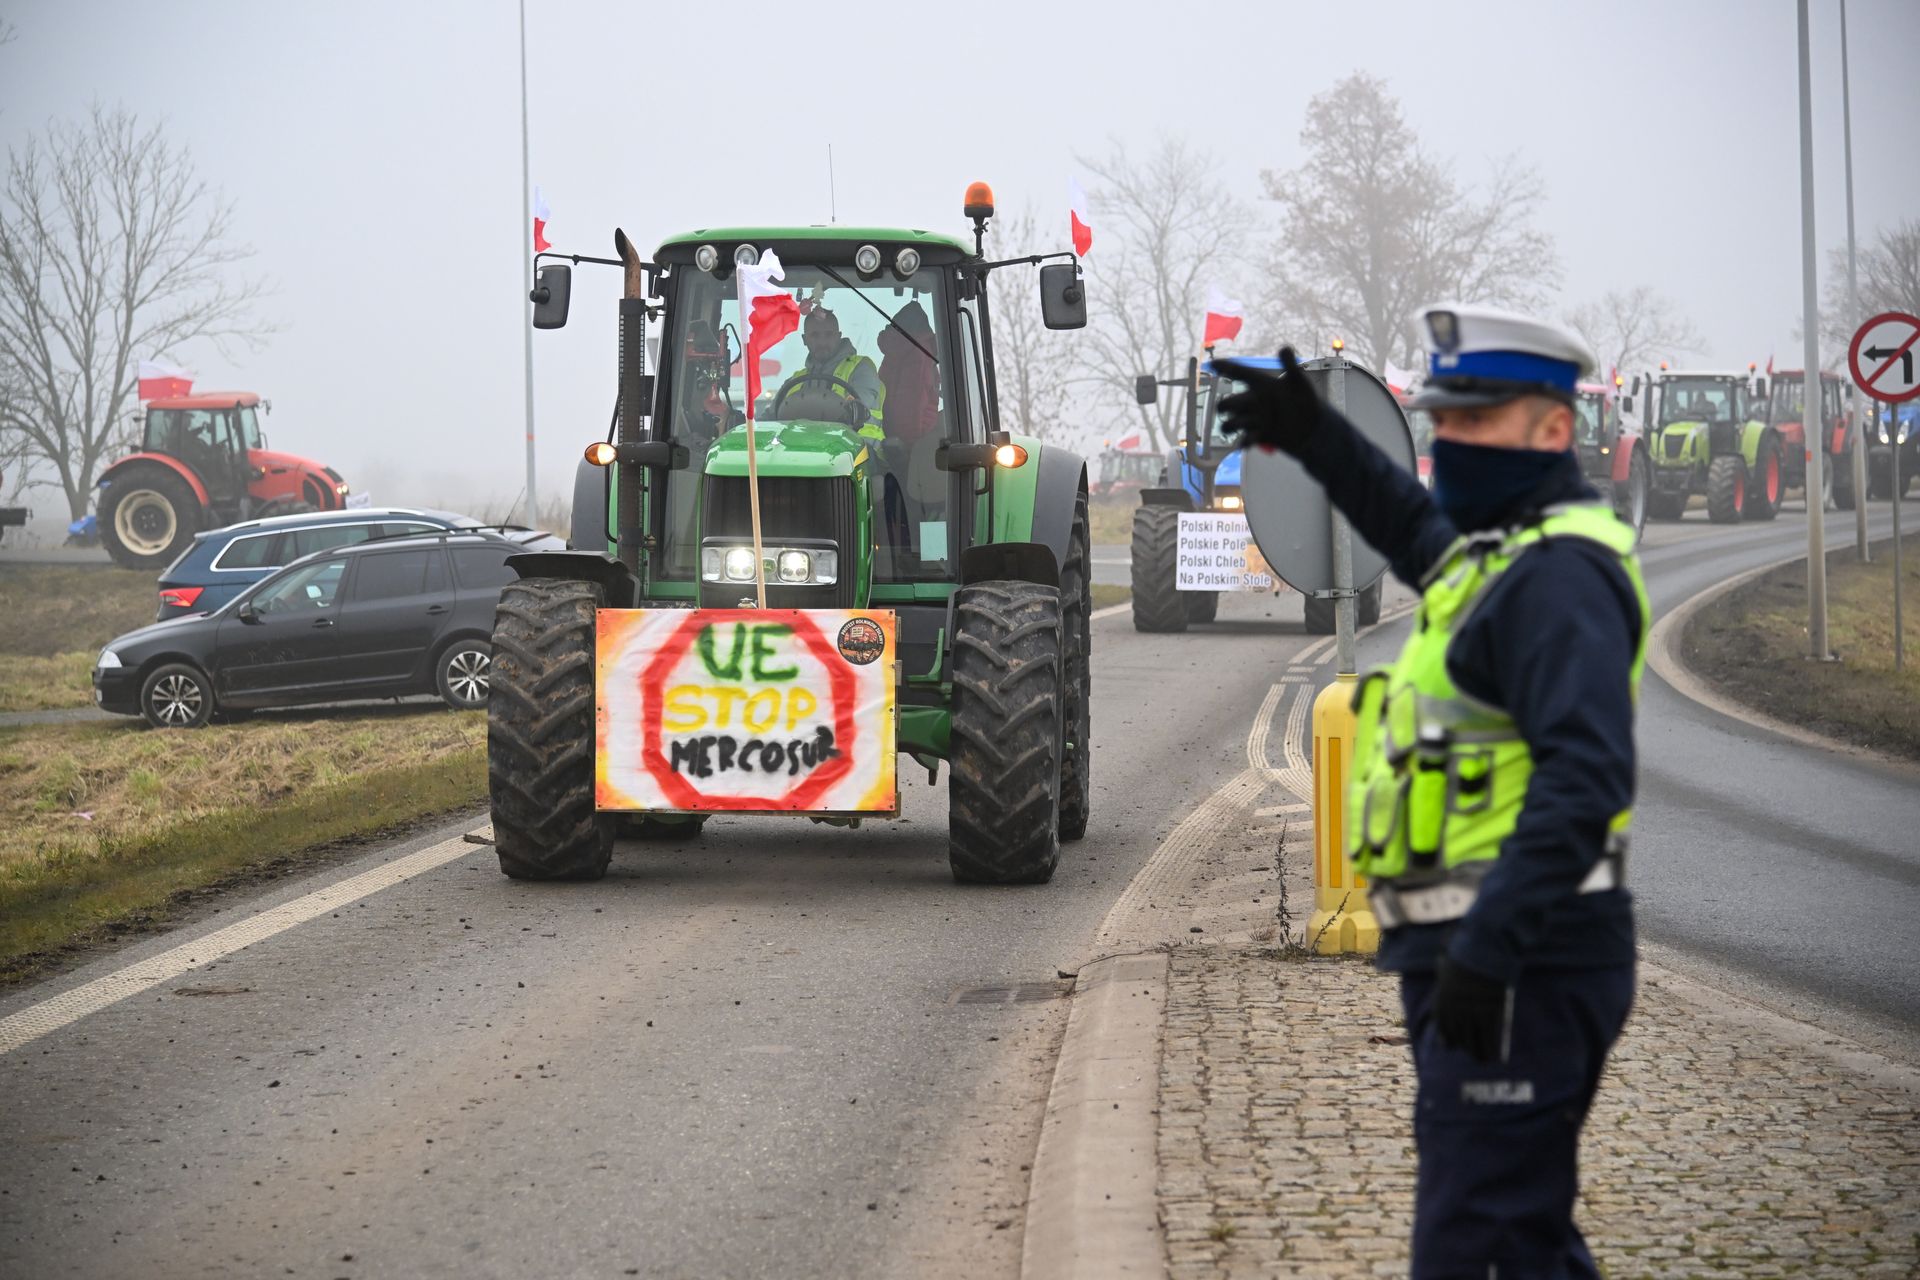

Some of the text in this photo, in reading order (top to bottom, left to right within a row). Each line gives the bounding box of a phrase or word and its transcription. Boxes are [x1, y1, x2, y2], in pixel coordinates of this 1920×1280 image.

[1181, 520, 1213, 532] Polski
[1180, 538, 1246, 550] Polskie Pole
[1180, 555, 1246, 568] Polski Chleb
[1179, 573, 1270, 586] Na Polskim Stole
[697, 622, 799, 681] UE
[663, 684, 817, 732] STOP
[671, 725, 843, 778] MERCOSUR
